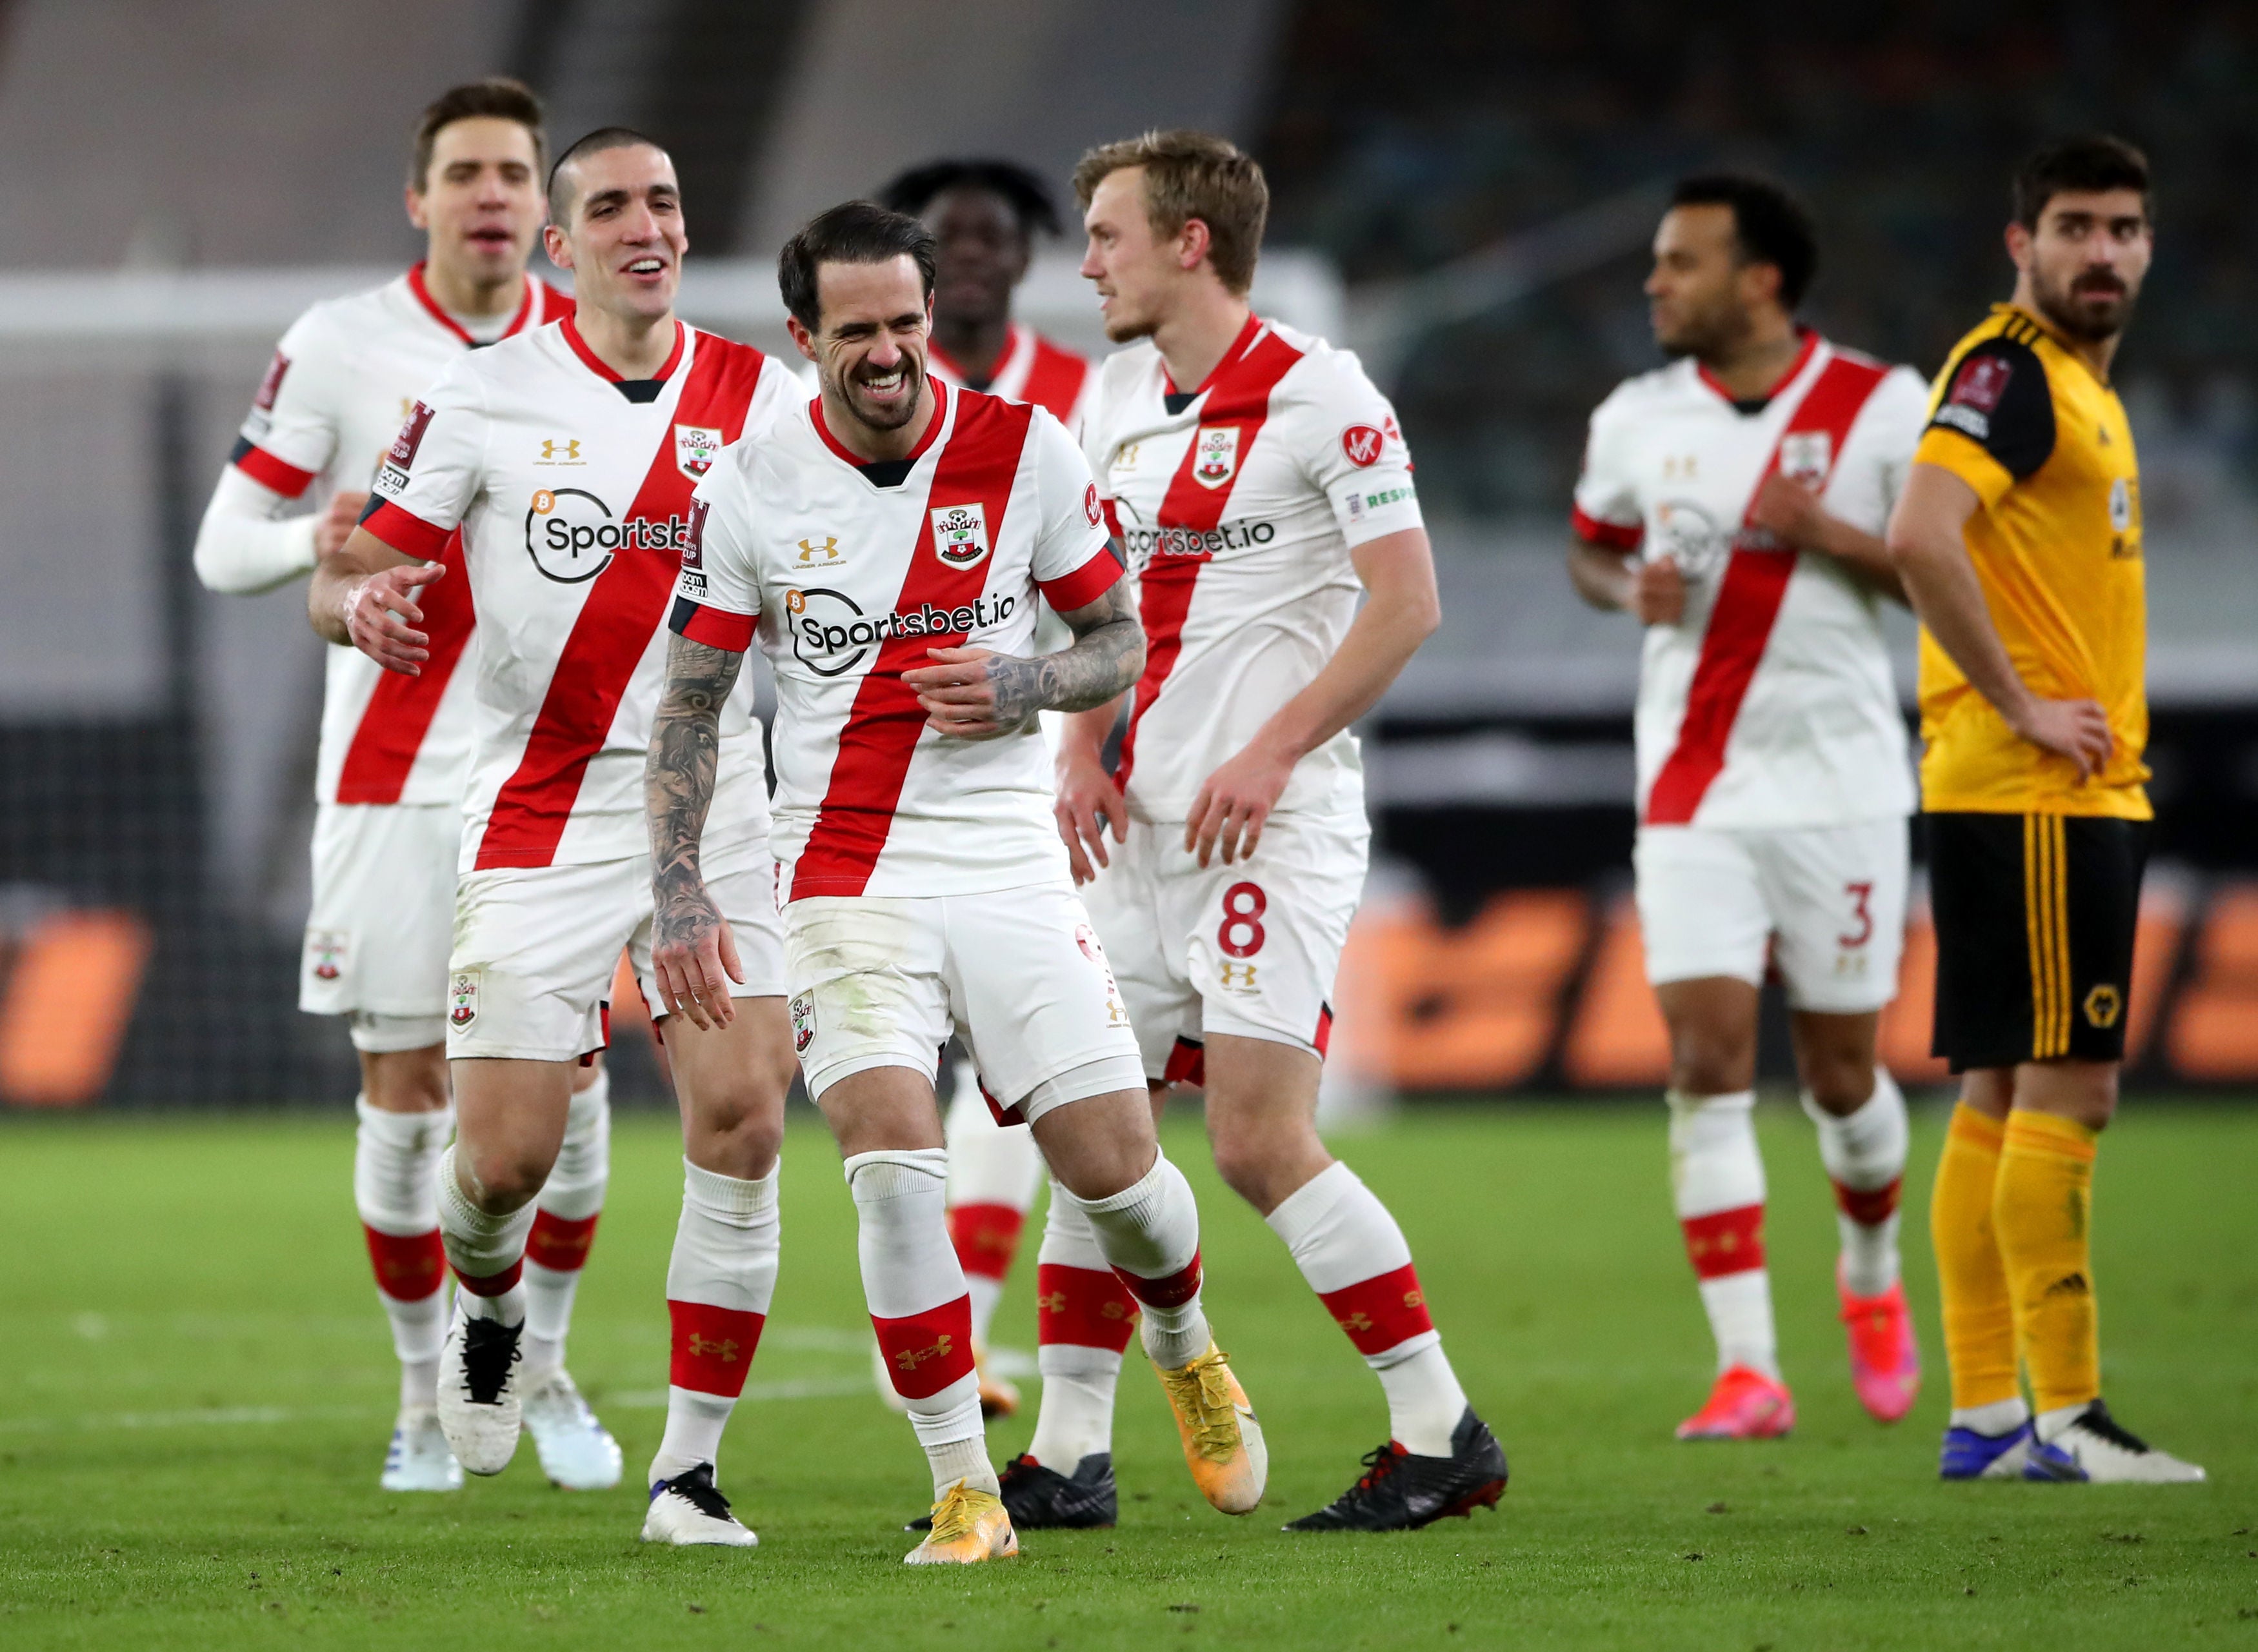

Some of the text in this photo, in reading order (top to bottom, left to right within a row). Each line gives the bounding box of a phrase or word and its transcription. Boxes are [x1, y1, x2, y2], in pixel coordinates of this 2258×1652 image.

[391, 446, 408, 459] CUP
[683, 548, 697, 561] CUP
[801, 593, 1015, 655] Sportsbet.io
[1217, 881, 1267, 959] 8
[1838, 883, 1874, 949] 3
